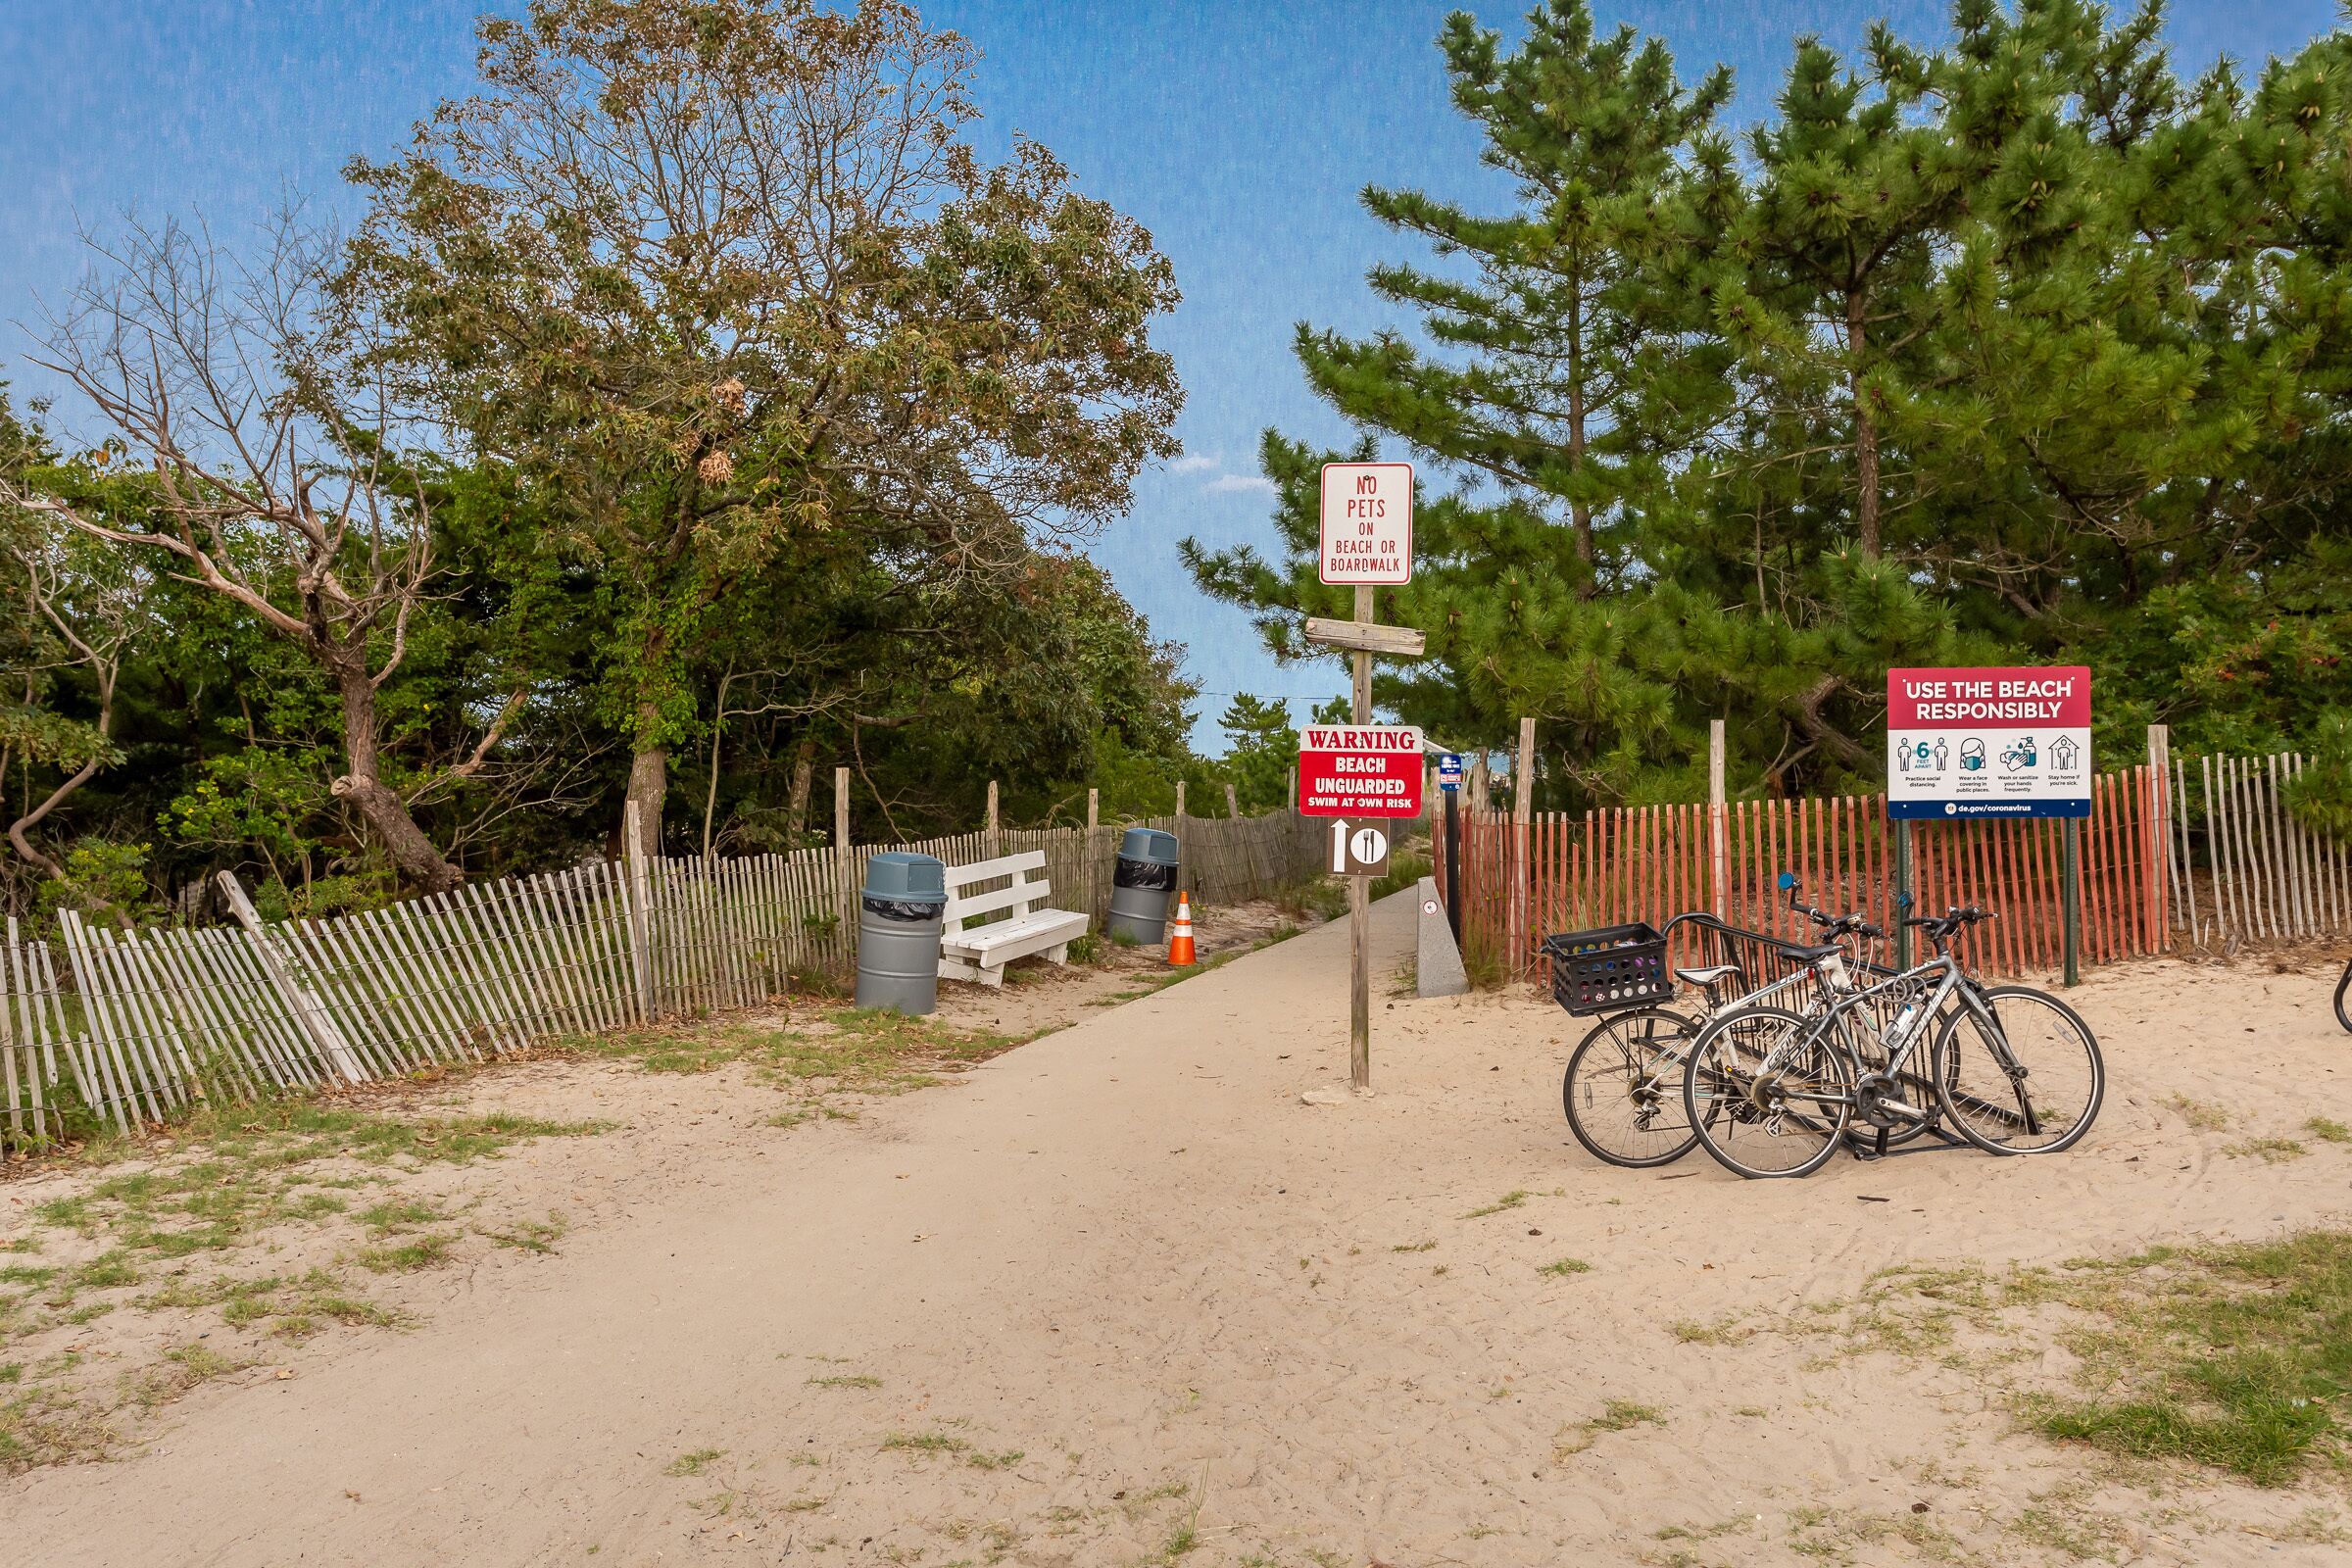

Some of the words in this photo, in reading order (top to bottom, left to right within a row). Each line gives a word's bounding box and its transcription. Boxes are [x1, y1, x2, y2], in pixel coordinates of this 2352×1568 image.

[1357, 476, 1377, 495] NO
[1348, 499, 1385, 517] PETS
[1359, 522, 1373, 535] ON
[1336, 541, 1372, 553] BEACH
[1381, 541, 1395, 553] OR
[1330, 558, 1399, 572] BOARDWALK
[1906, 681, 1946, 699] USE
[1952, 681, 1993, 698] THE
[1999, 680, 2071, 697] BEACH
[1916, 702, 2062, 720] RESPONSIBLY
[1308, 731, 1415, 749] WARNING
[1917, 742, 1929, 759] 6
[1335, 757, 1386, 772] BEACH
[1315, 778, 1405, 794] UNGUARDED
[1308, 797, 1338, 807] SWIM
[1341, 798, 1354, 807] AT
[1357, 798, 1382, 808] OWN
[1387, 798, 1412, 808] RISK
[1958, 804, 2031, 813] de.gov/coronavirus
[1892, 984, 1948, 1072] cannondale
